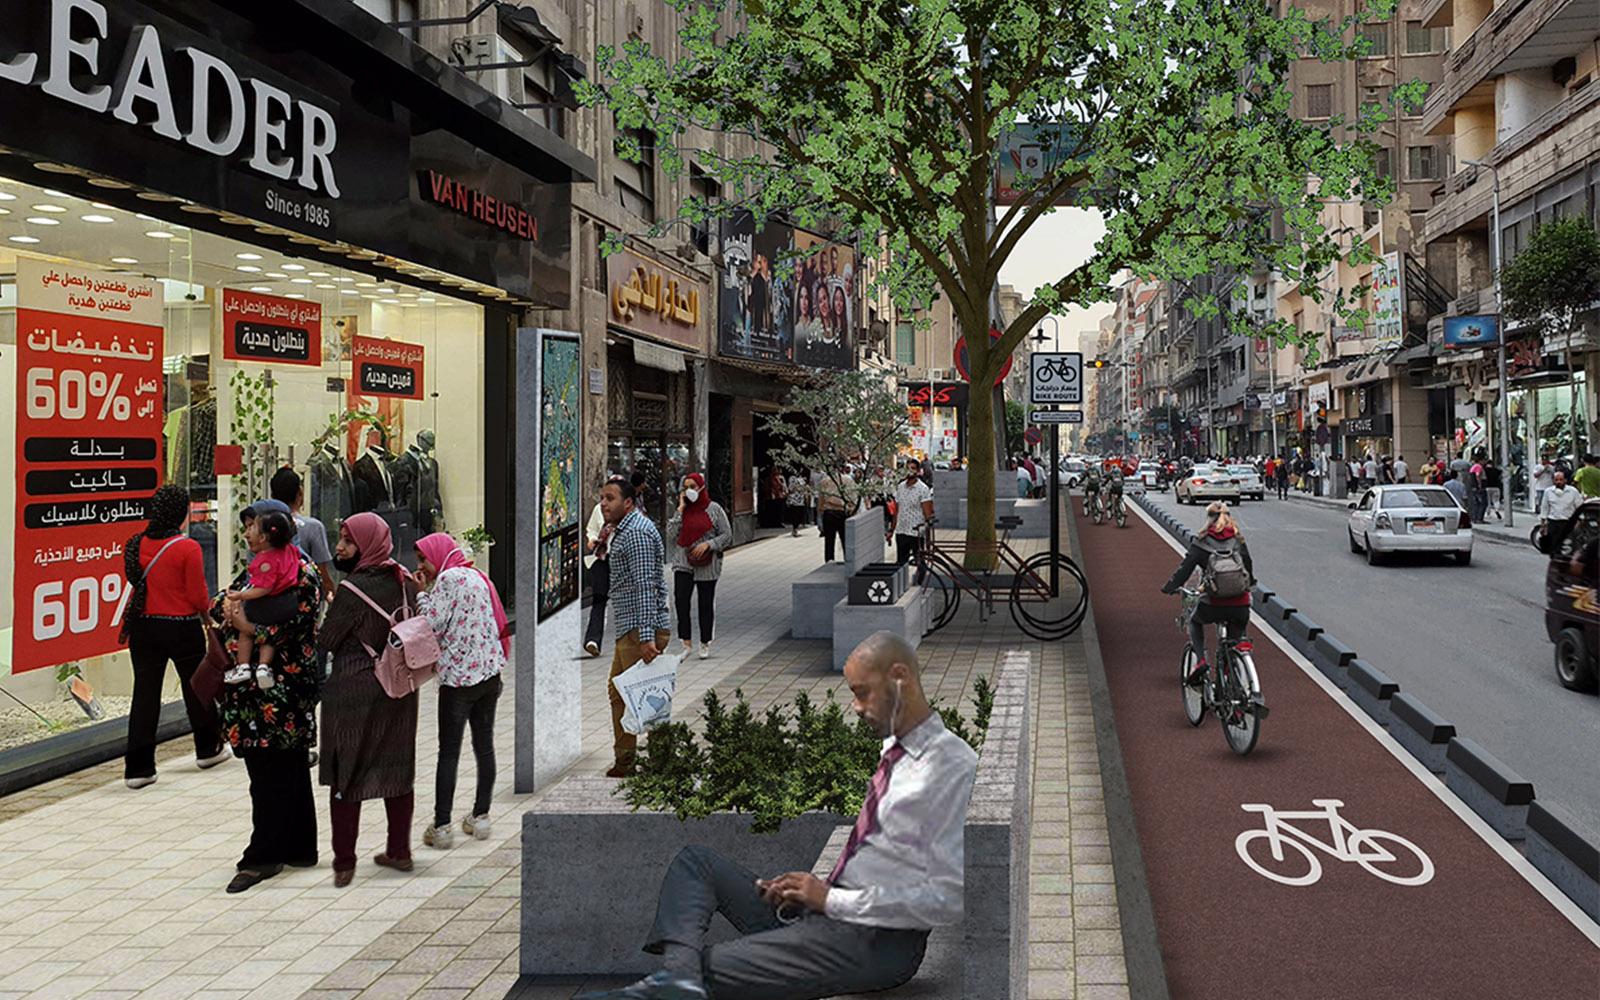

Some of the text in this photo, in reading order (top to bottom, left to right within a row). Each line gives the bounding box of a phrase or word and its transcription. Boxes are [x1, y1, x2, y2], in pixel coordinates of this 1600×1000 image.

[265, 189, 331, 228] Since 1985
[430, 170, 539, 242] VAN HEUSEN
[61, 272, 93, 291] واحصل
[94, 279, 128, 293] قطعتين
[68, 293, 132, 312] قطعتين هدية
[240, 299, 265, 317] واحصل
[266, 302, 289, 321] بنطلون
[27, 328, 154, 363] تخفيضات
[242, 327, 305, 354] بنطلون هدية
[365, 344, 384, 359] واحصل
[134, 377, 157, 396] تصل
[366, 367, 411, 390] قميص هدية
[1060, 384, 1077, 392] مسار
[26, 367, 131, 421] 60%
[69, 470, 127, 491] جاكيت
[41, 501, 145, 527] بنطلون كلاسيك
[76, 544, 102, 563] جميع
